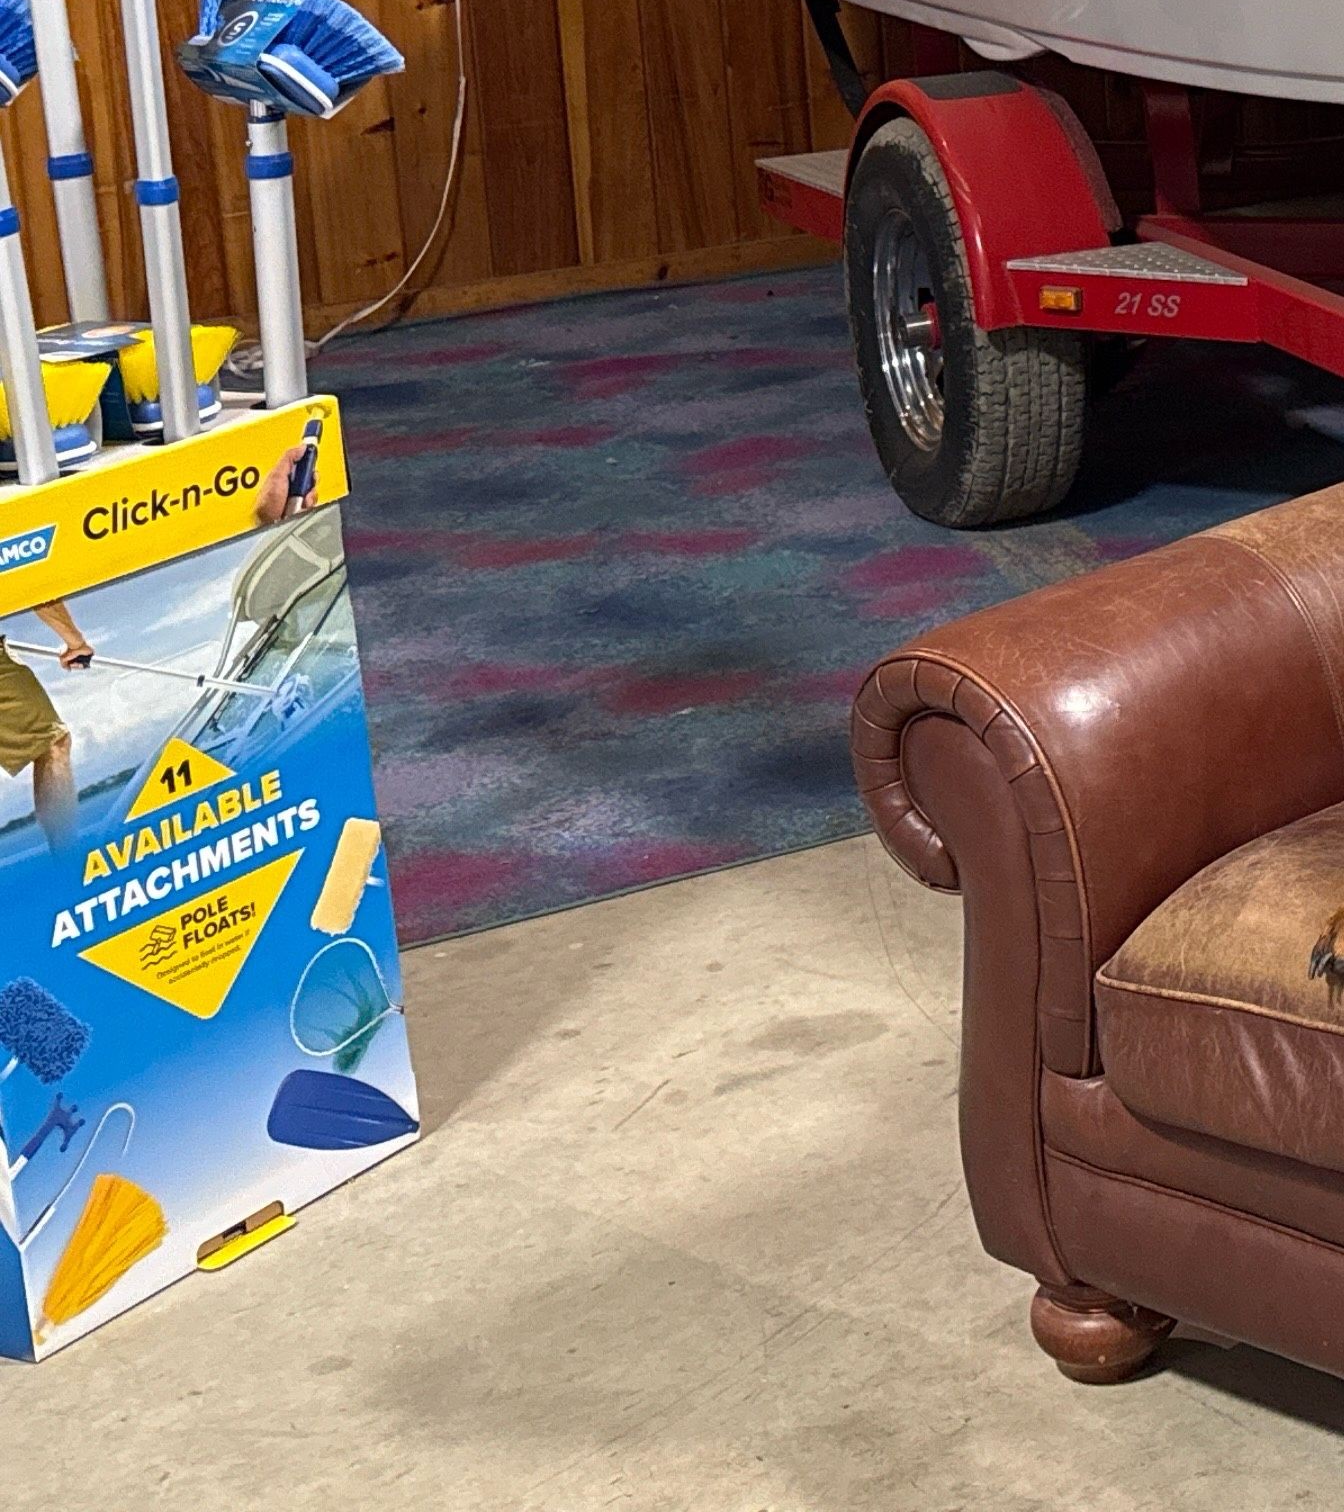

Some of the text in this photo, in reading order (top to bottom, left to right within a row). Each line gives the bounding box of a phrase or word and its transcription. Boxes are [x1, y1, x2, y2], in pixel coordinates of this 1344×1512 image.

[1115, 292, 1181, 317] 21 SS
[82, 465, 260, 541] Click-n-Go
[160, 759, 193, 794] 11
[82, 769, 284, 887] AVAILABLE
[51, 798, 321, 948] ATTACHMENTS
[180, 895, 229, 931] POLE
[182, 902, 257, 949] FLOATS!
